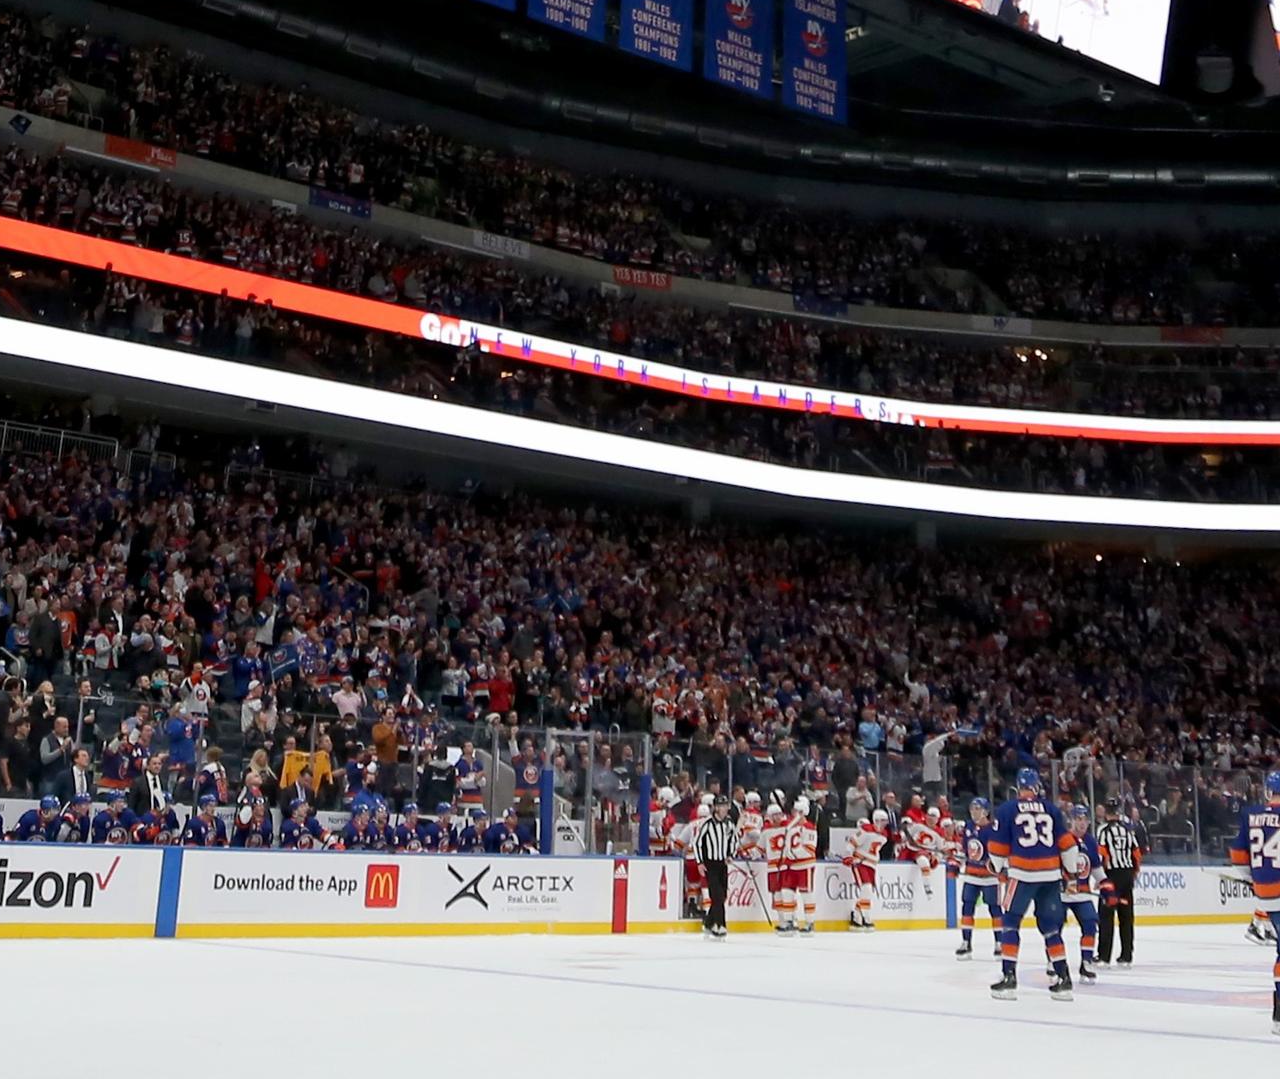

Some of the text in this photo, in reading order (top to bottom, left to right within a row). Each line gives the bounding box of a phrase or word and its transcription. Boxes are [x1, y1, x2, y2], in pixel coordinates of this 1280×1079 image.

[570, 348, 649, 383] YORK
[681, 373, 887, 420] ISLANDERS
[1015, 813, 1054, 848] 33
[1114, 836, 1128, 851] 37
[214, 873, 358, 897] Download the App
[492, 876, 574, 892] ARCTIX
[1154, 895, 1169, 907] App
